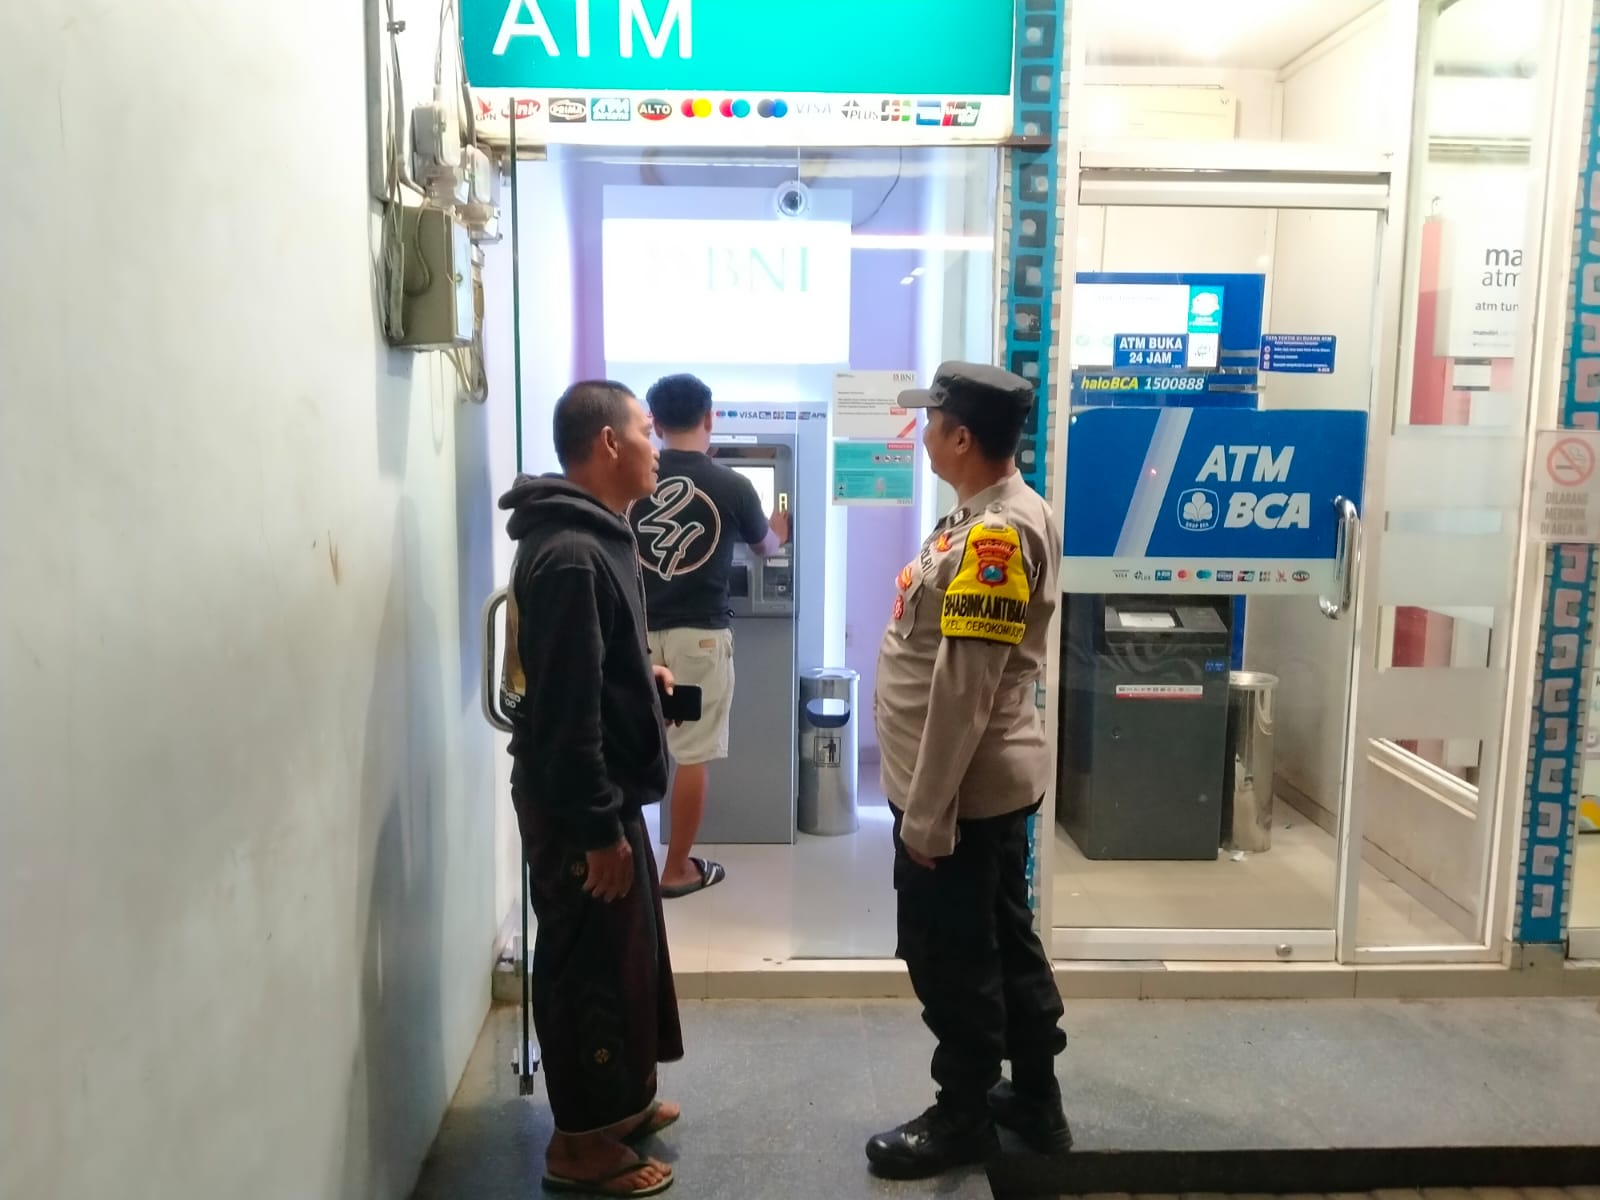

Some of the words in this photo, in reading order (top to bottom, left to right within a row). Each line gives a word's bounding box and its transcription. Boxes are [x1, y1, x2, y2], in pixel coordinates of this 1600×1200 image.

[492, 0, 693, 58] ATM
[639, 103, 672, 114] ALTO
[795, 103, 832, 114] VISA
[850, 109, 879, 121] PLUS
[706, 246, 809, 292] BNI
[1475, 302, 1498, 312] atm
[1119, 336, 1146, 349] ATM
[1149, 336, 1182, 350] BUKA
[1129, 352, 1143, 364] 24
[1146, 352, 1172, 364] JAM
[1081, 376, 1139, 390] haloBCA
[1144, 377, 1204, 391] 1500888
[740, 411, 758, 419] VISA
[1195, 445, 1295, 483] ATM
[1224, 492, 1310, 529] BCA
